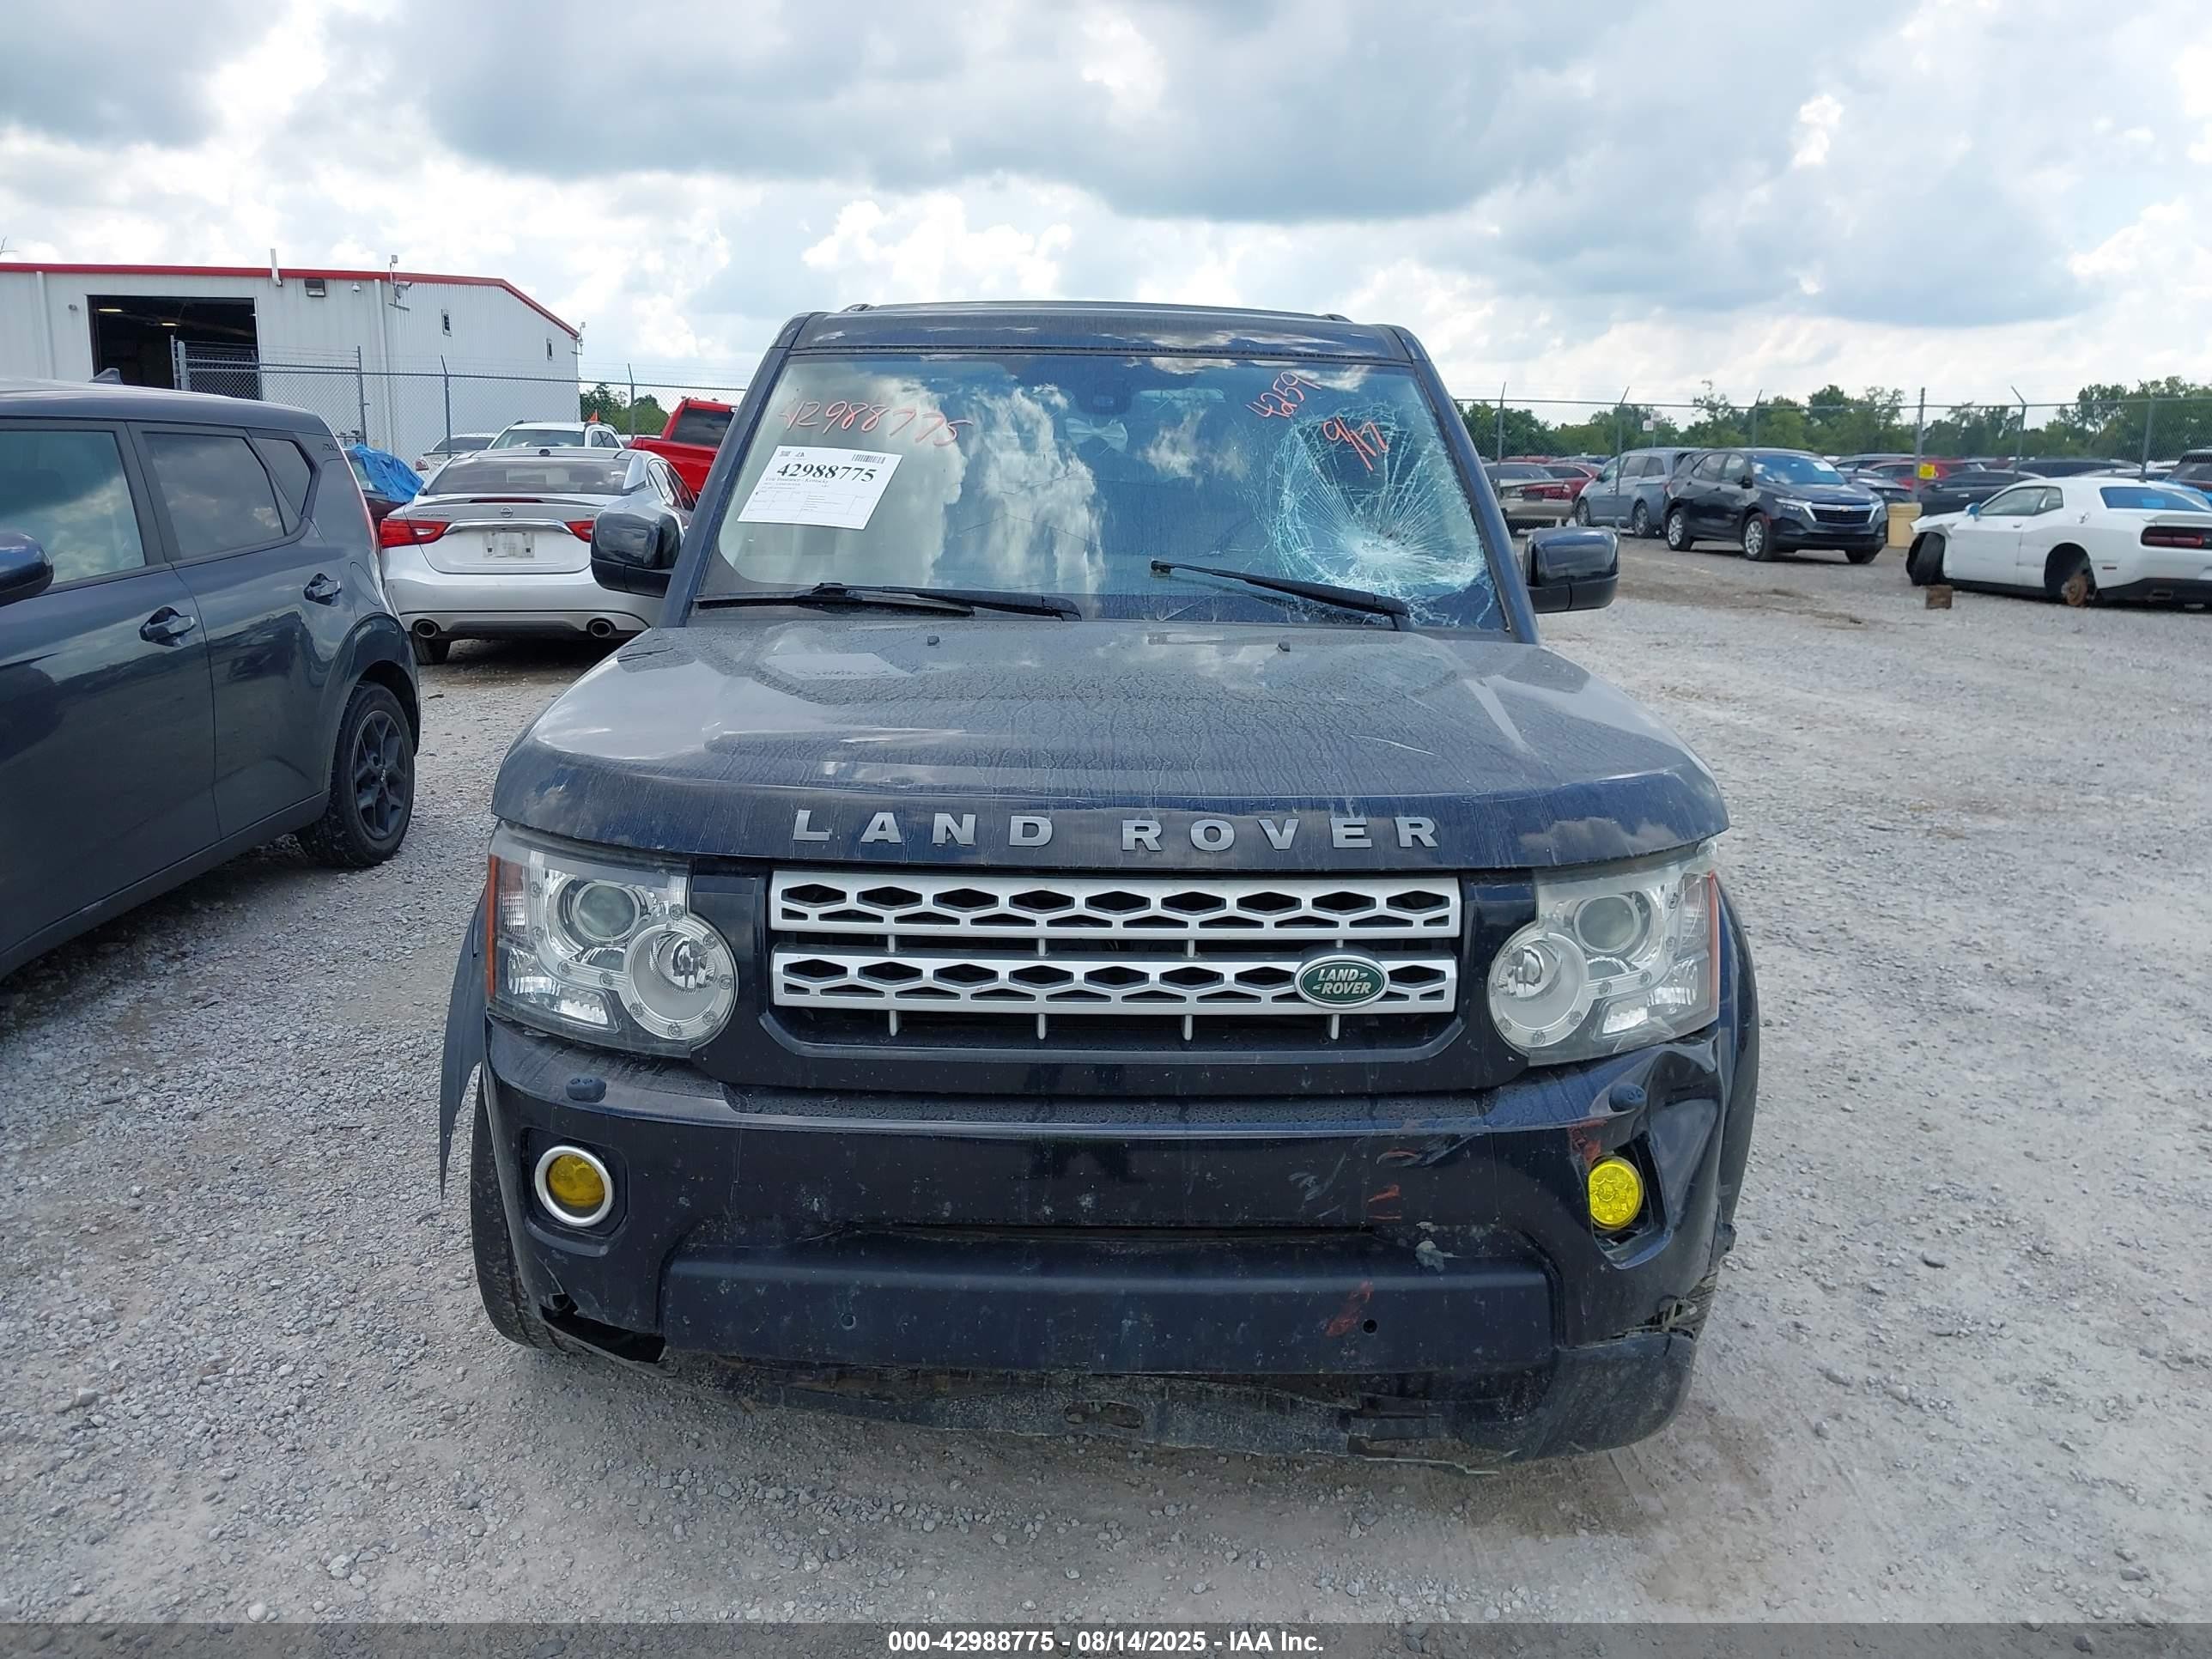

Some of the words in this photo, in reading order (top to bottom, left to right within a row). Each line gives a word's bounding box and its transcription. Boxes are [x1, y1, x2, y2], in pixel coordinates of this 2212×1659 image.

[1245, 371, 1322, 417] 4259
[778, 400, 974, 447] 42988775
[776, 463, 877, 483] 42988775
[793, 810, 1054, 847] LAND
[1121, 817, 1438, 851] ROVER
[1317, 969, 1358, 981] LAND
[1322, 981, 1372, 994] ROVER
